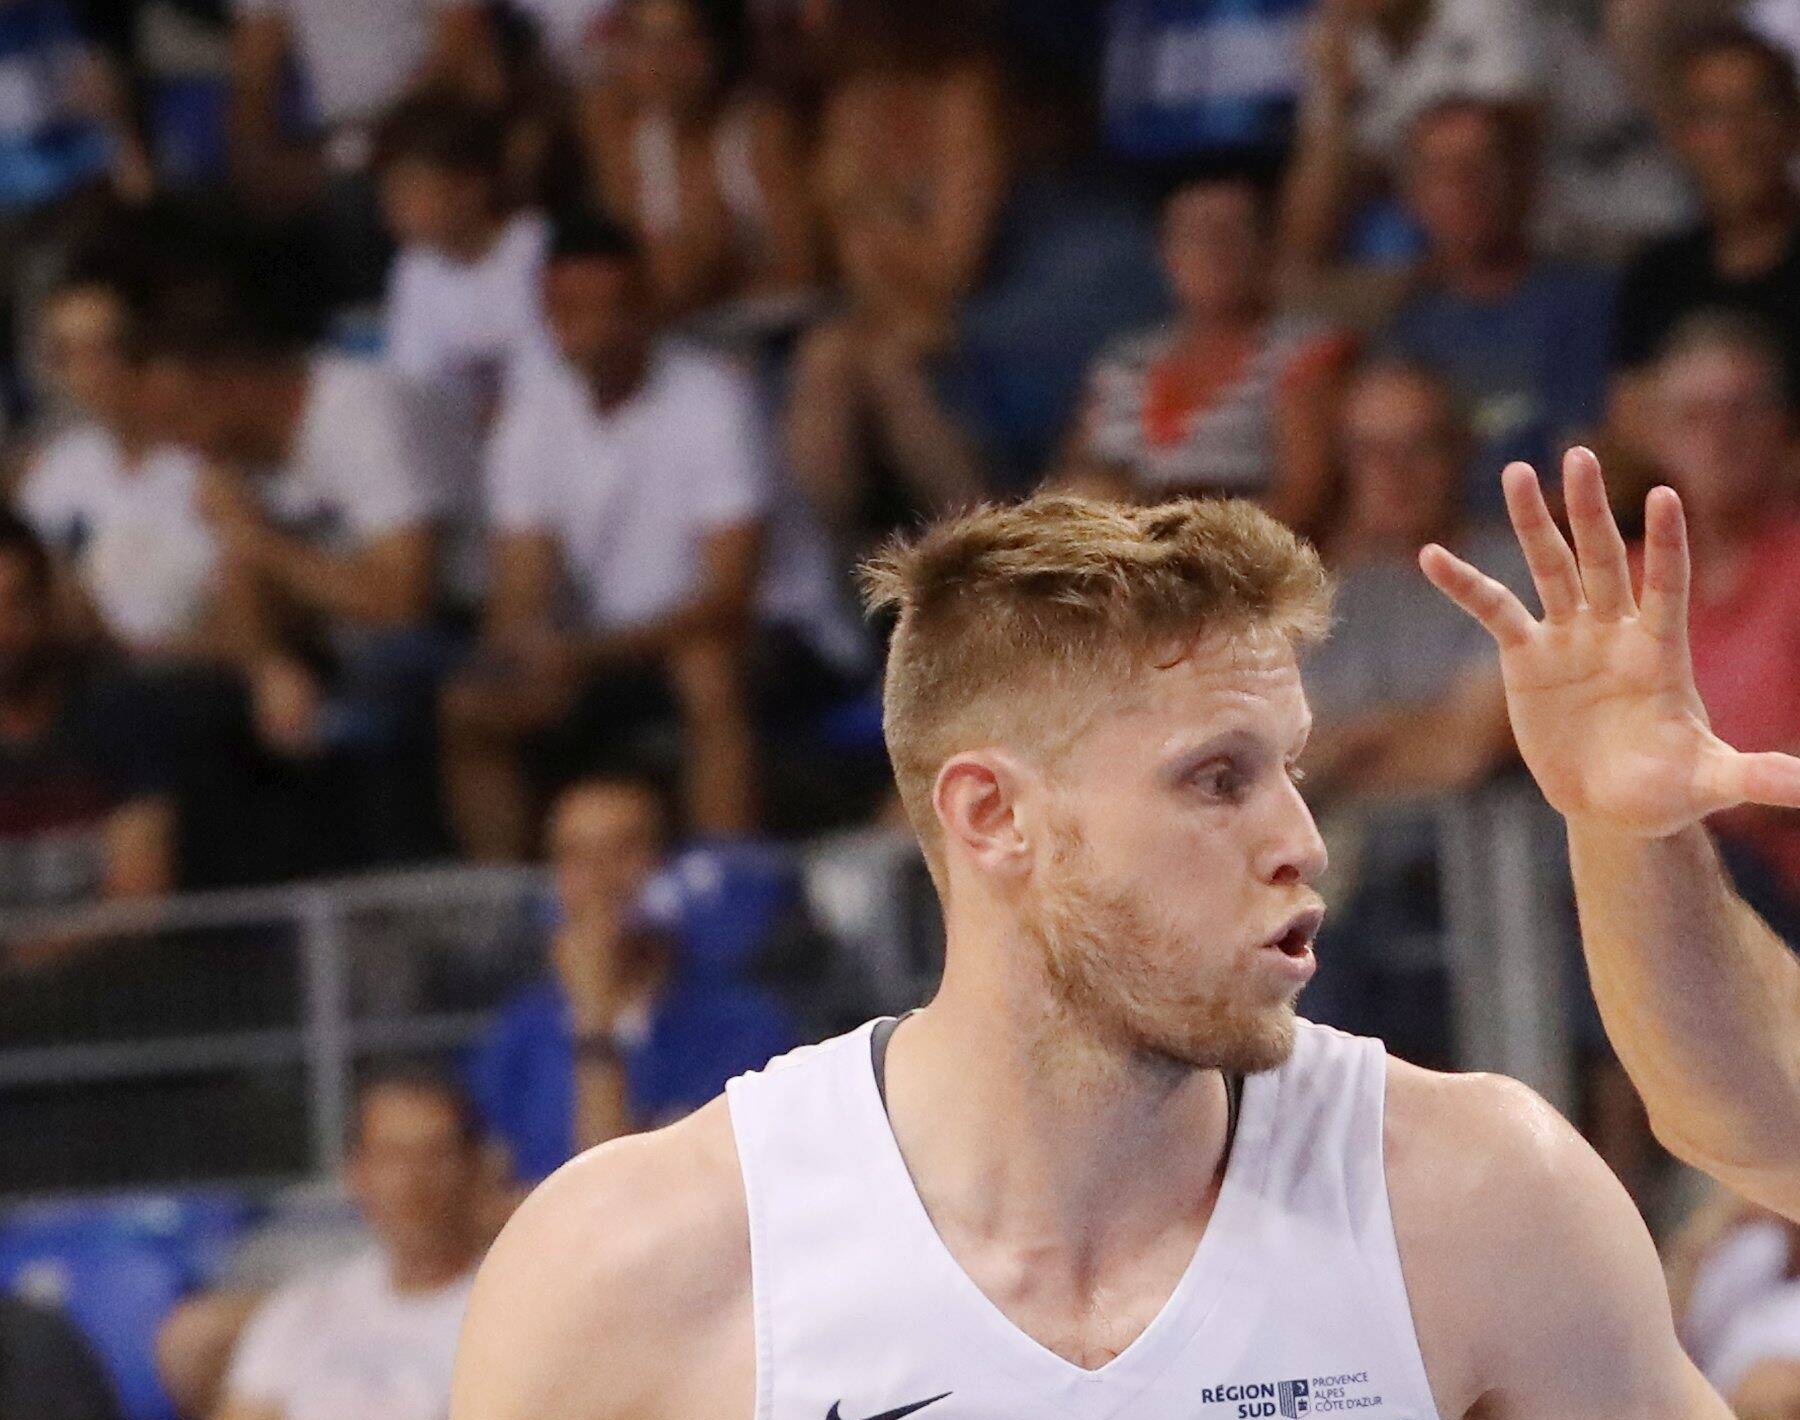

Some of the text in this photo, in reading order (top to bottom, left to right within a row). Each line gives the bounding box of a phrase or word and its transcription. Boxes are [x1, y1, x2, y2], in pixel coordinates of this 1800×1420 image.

[1312, 1372, 1369, 1388] PROVENCE
[1202, 1382, 1275, 1403] RÉGION
[1314, 1387, 1345, 1400] ALPES
[1238, 1402, 1276, 1419] SUD
